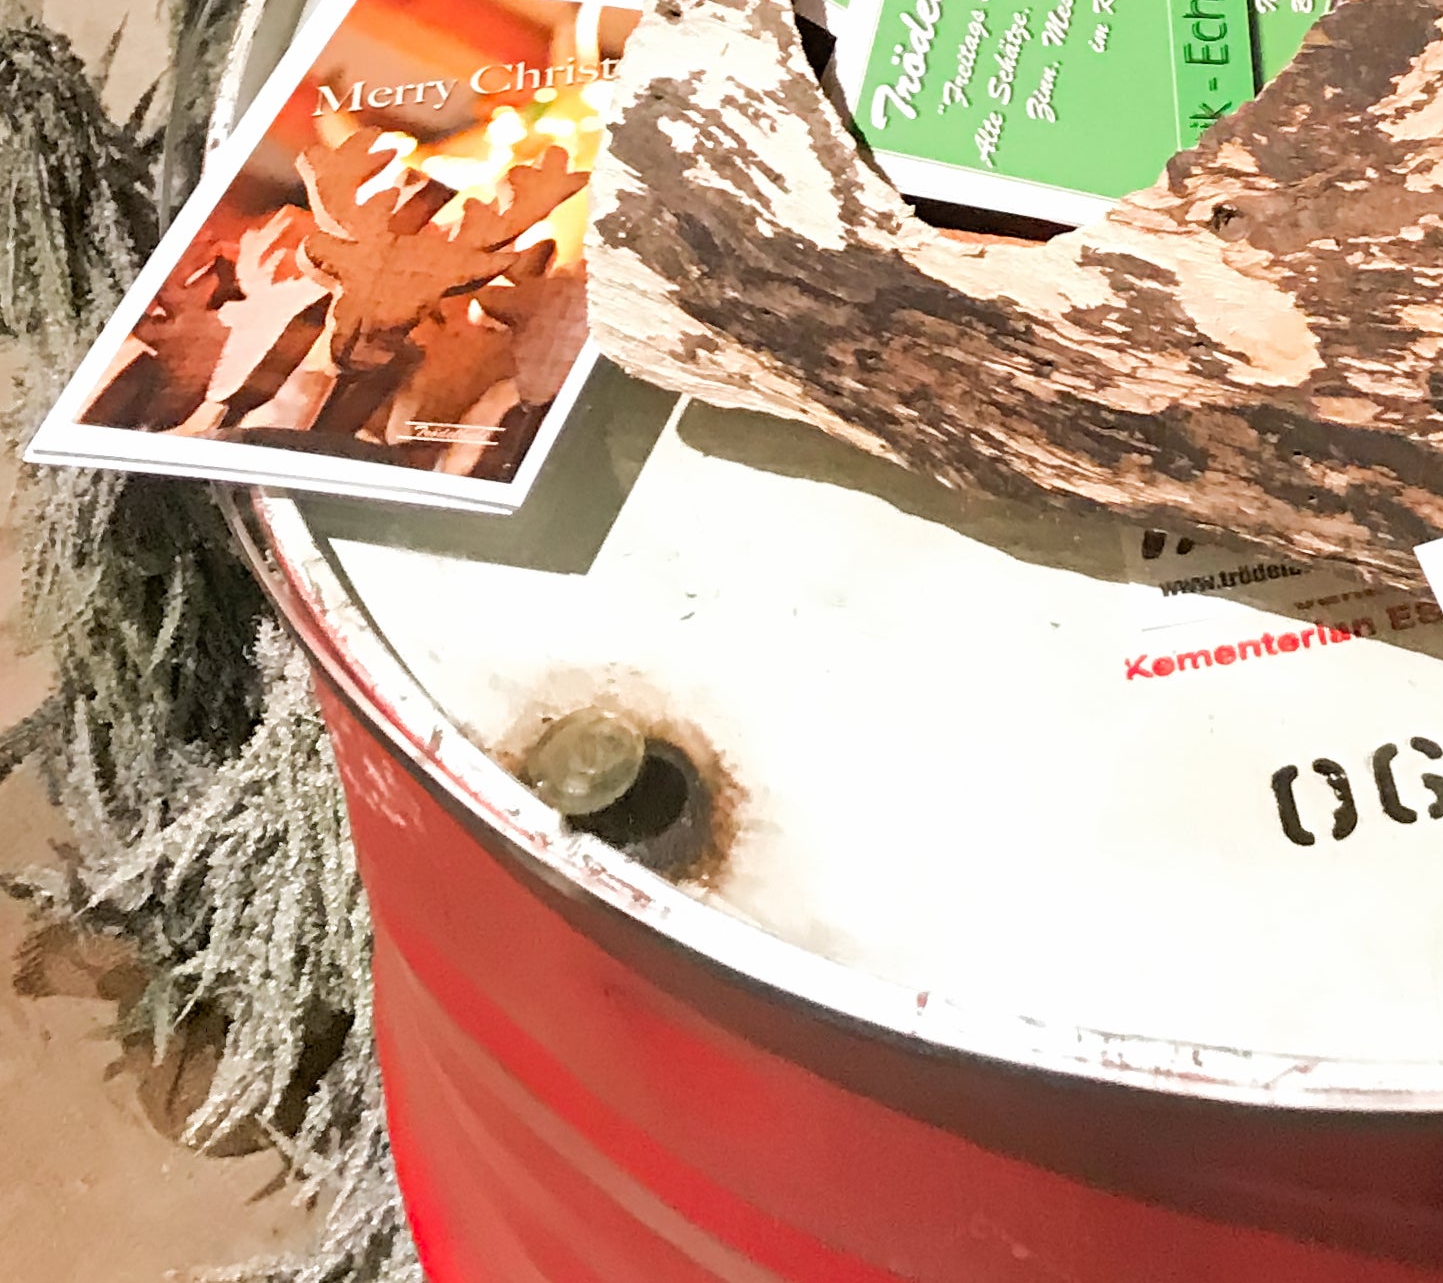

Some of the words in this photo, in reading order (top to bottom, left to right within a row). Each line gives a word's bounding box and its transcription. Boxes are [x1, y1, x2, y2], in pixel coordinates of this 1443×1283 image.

[1088, 21, 1111, 55] im
[311, 77, 459, 119] Merry
[469, 56, 622, 96] Christ
[972, 110, 1006, 169] Alte
